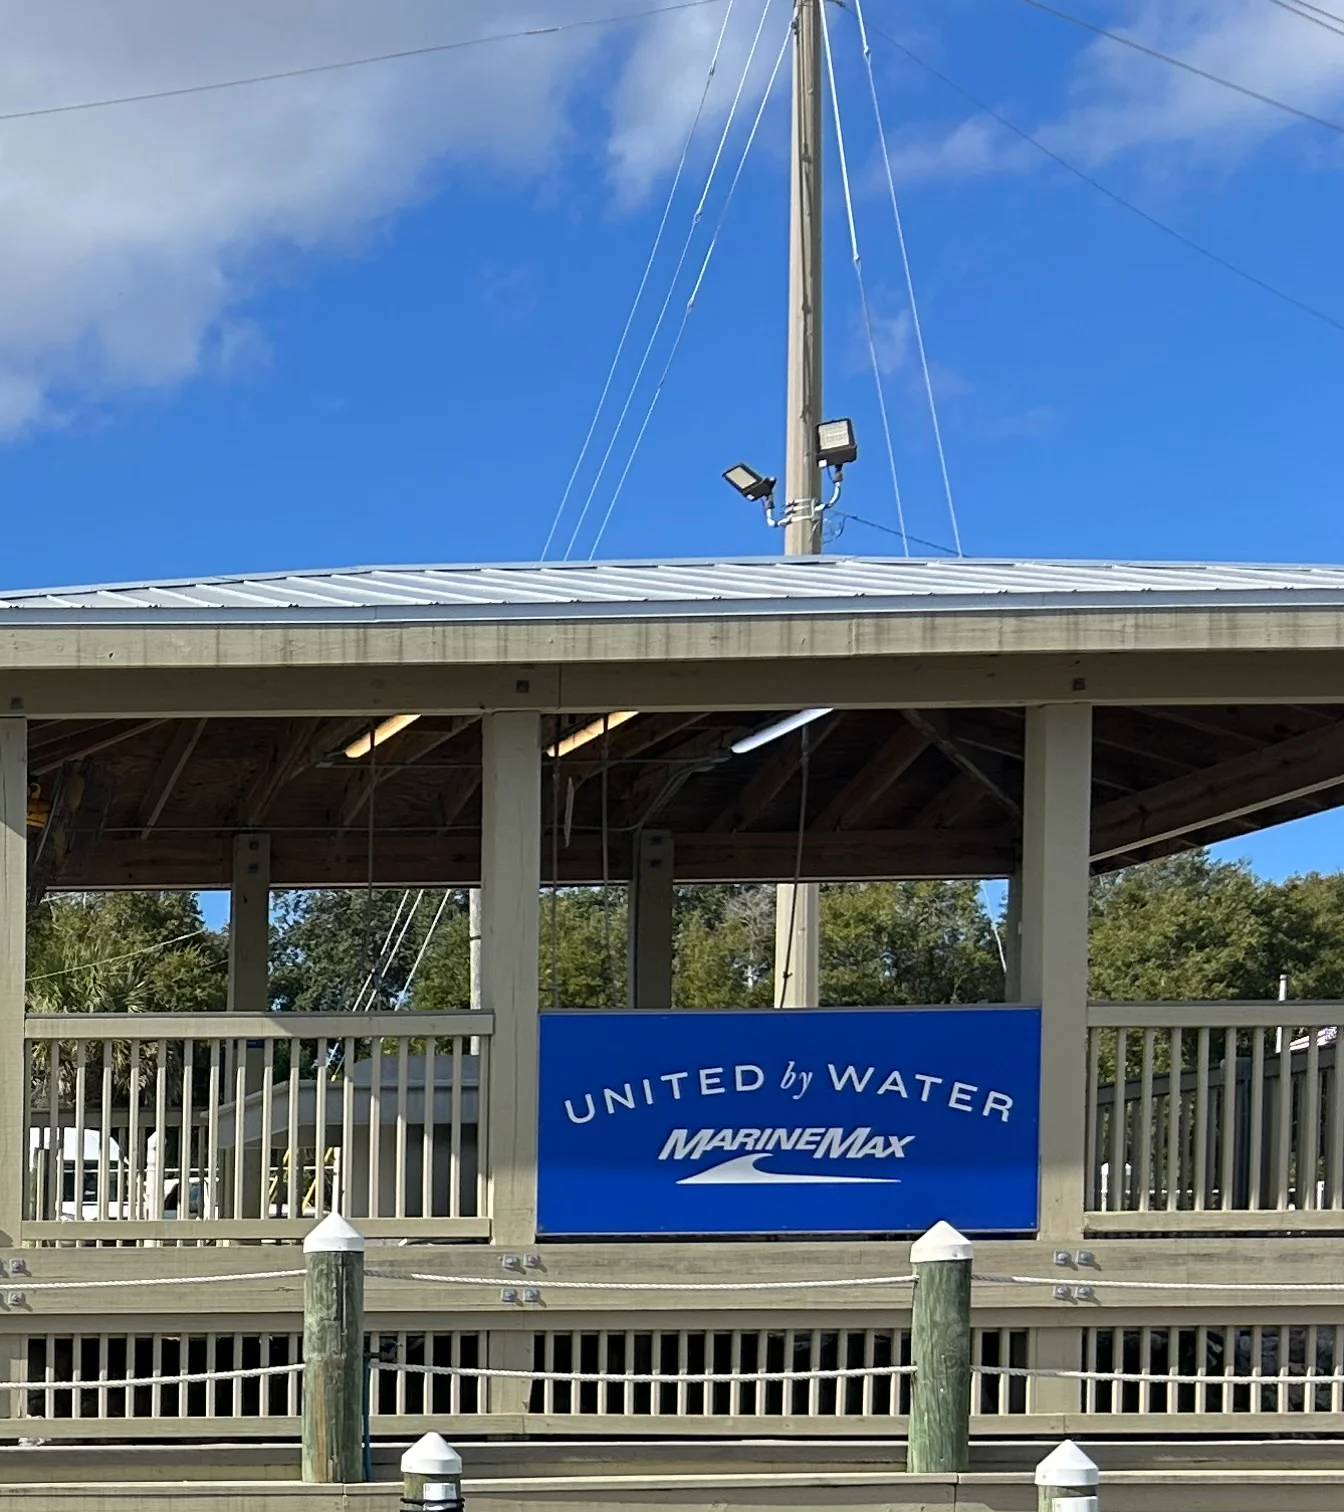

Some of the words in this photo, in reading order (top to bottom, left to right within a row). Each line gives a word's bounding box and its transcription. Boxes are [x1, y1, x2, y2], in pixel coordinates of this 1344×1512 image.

[564, 1065, 765, 1124] UNITED
[779, 1060, 813, 1100] by
[827, 1063, 1014, 1122] WATER
